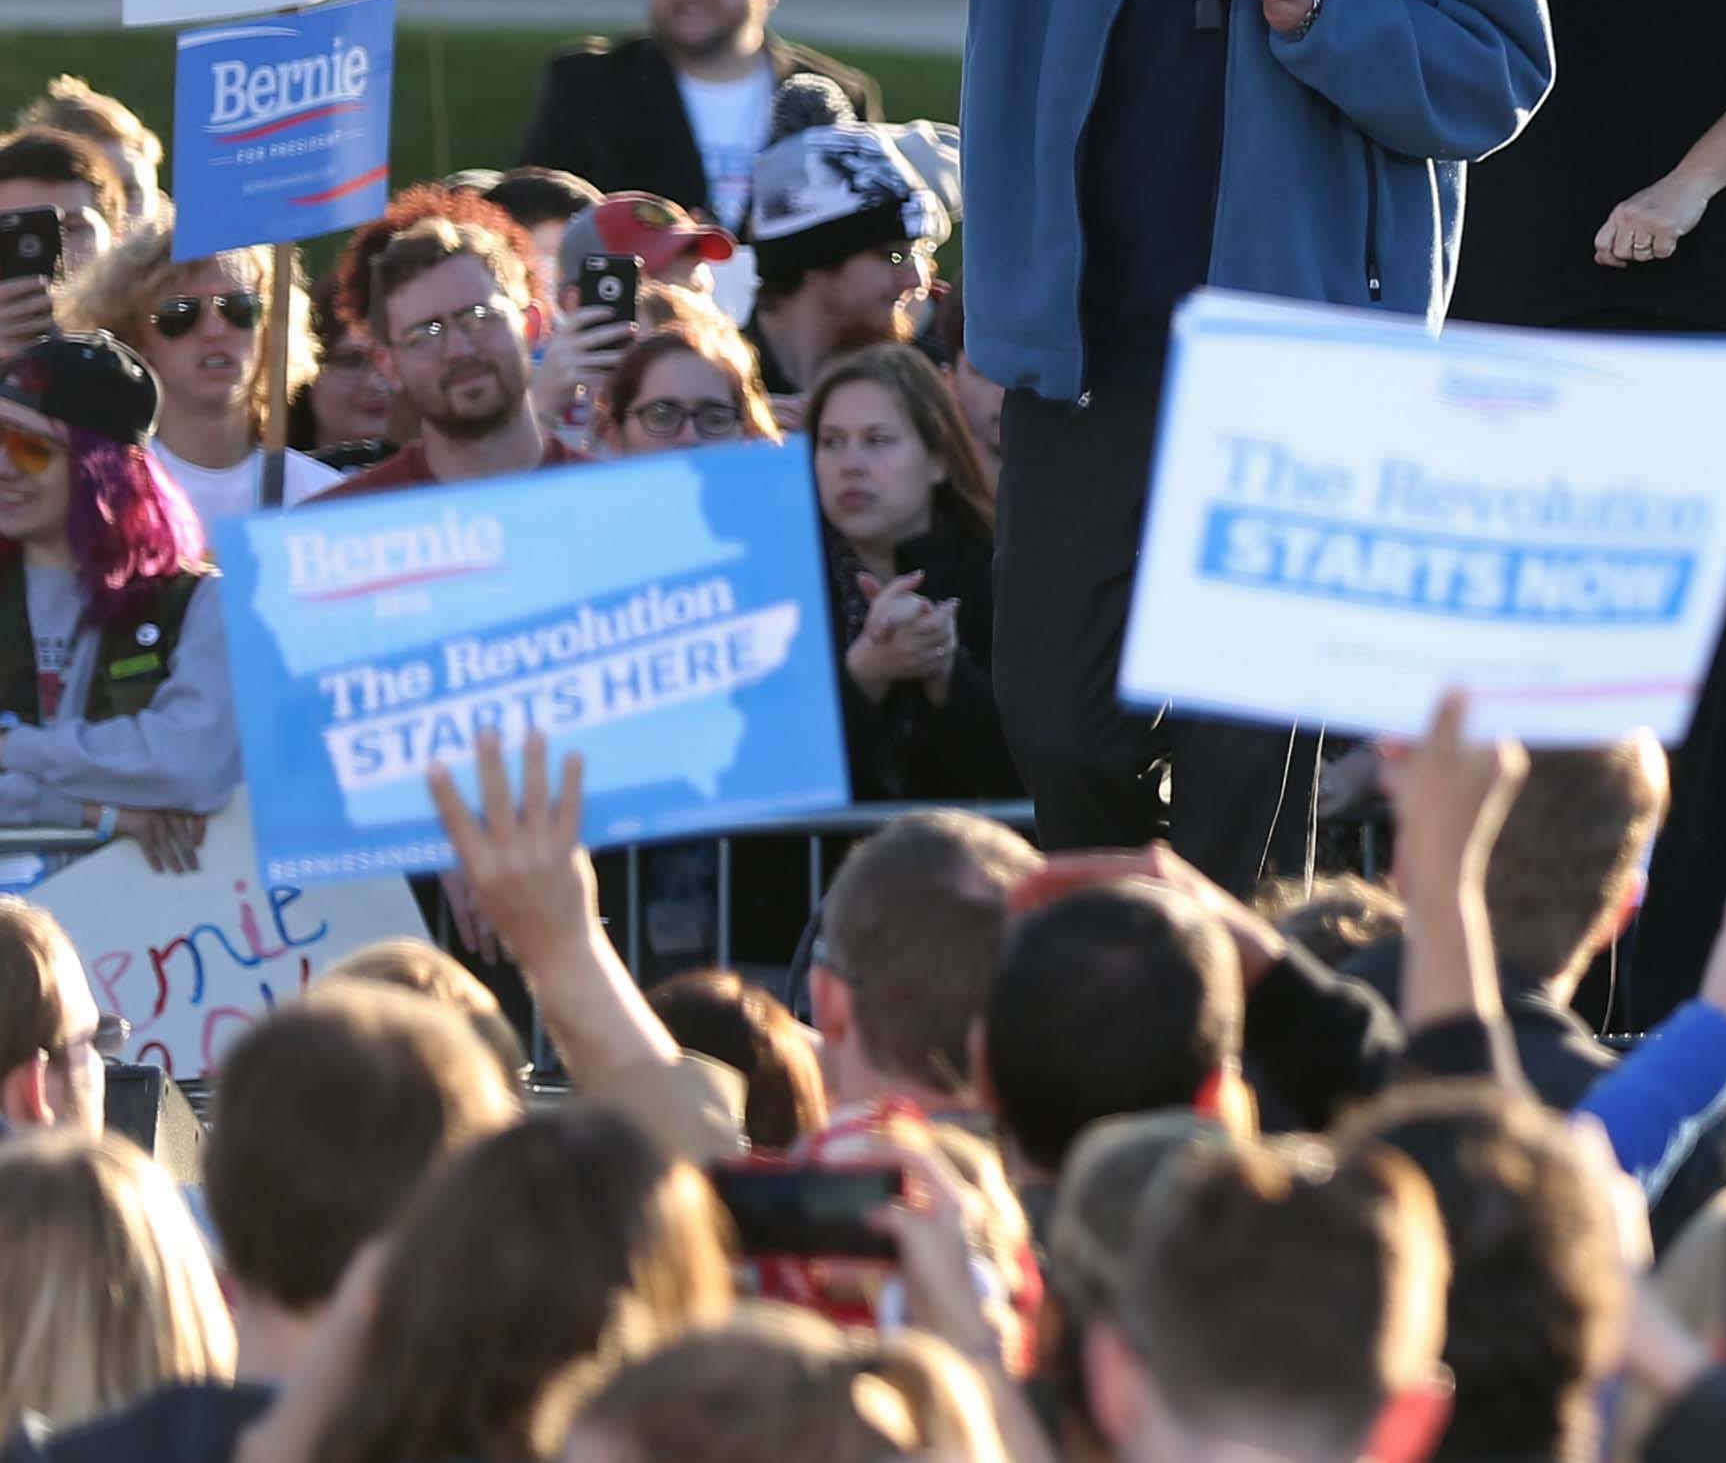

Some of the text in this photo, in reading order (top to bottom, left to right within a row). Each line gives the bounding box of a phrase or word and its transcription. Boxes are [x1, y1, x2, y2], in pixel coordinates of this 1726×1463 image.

[211, 36, 370, 123] Bernie
[1215, 433, 1708, 534] The Revolution
[282, 505, 508, 588] Bernie
[1225, 518, 1674, 616] STARTS NOW
[318, 576, 737, 719] The Revolution
[349, 623, 760, 776] STARTS HERE
